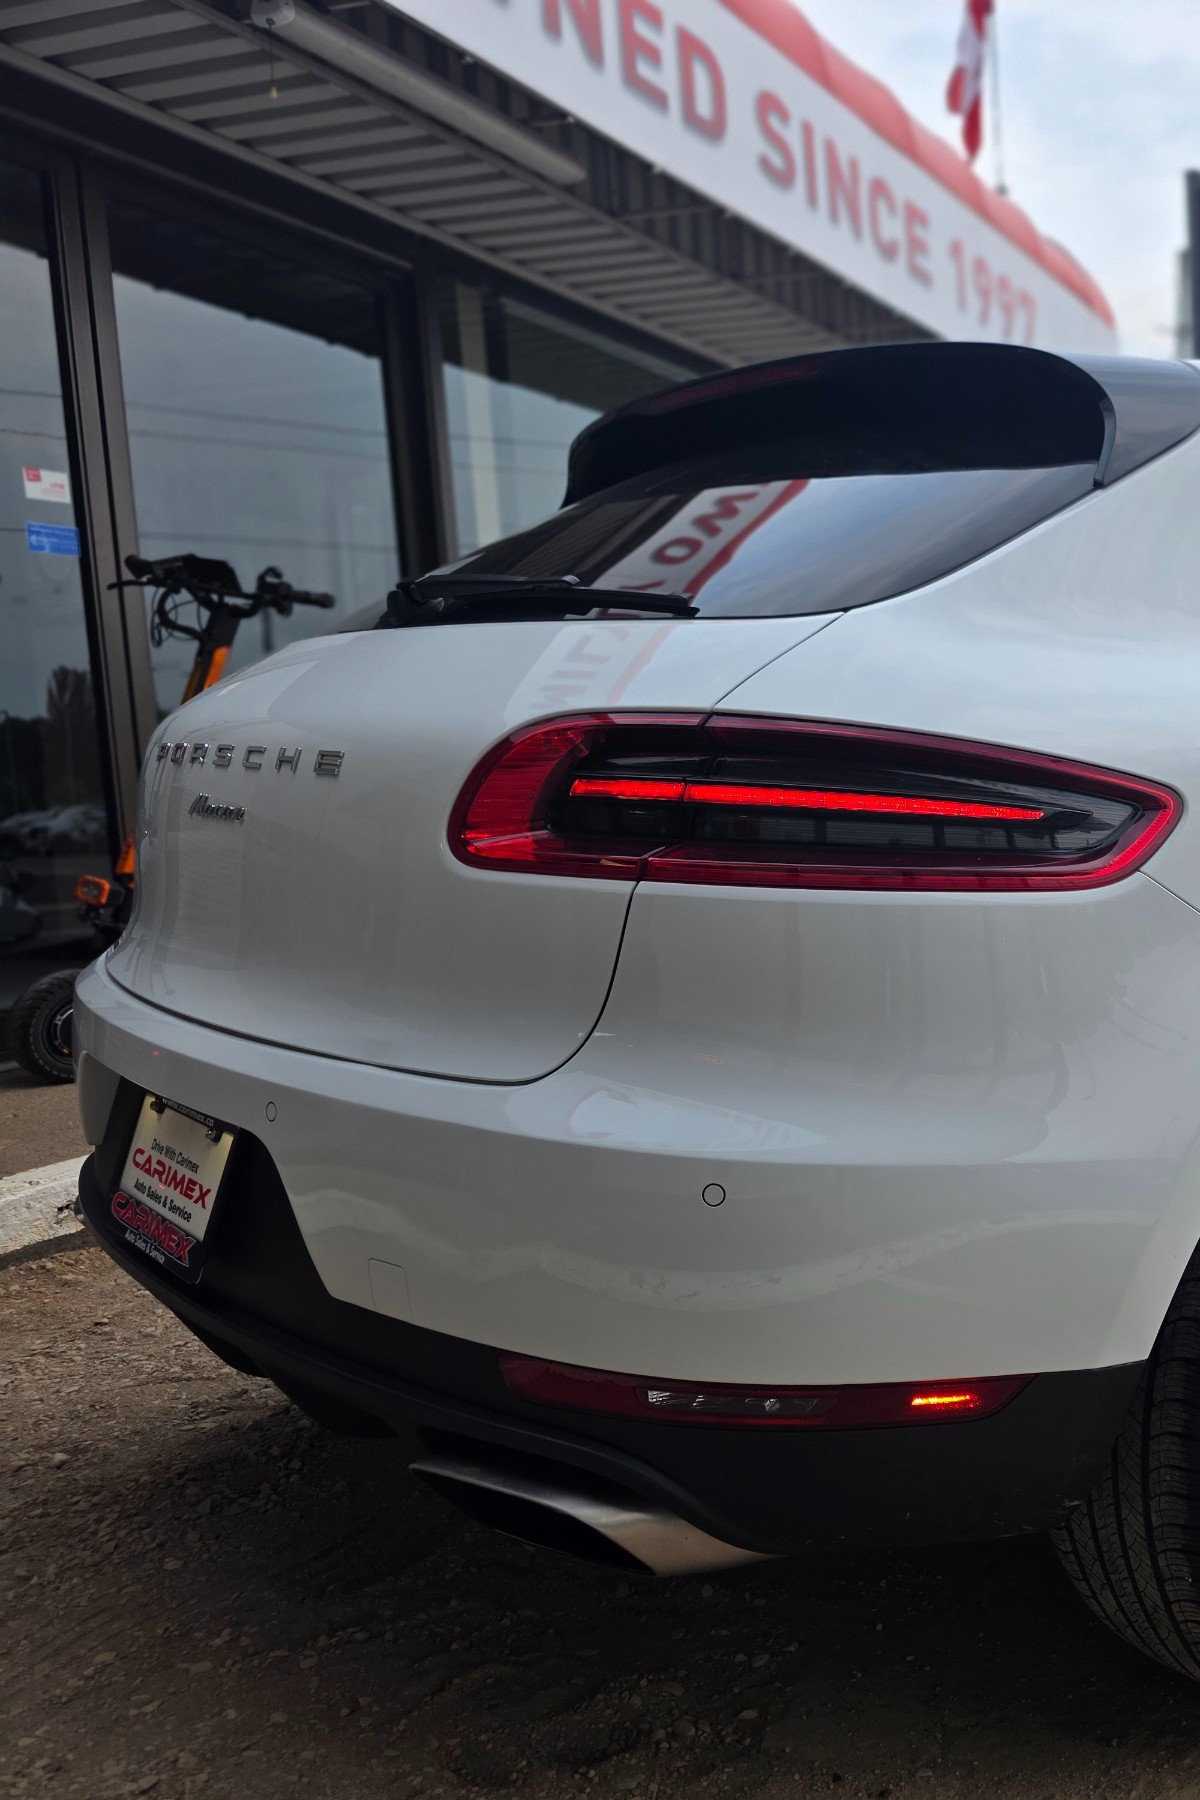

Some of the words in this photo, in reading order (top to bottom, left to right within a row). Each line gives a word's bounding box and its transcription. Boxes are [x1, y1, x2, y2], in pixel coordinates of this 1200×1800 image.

[493, 0, 729, 143] NED
[756, 88, 935, 289] SINCE
[948, 236, 1038, 346] 1997
[156, 742, 345, 776] PORSCHE
[188, 792, 246, 824] Macan
[151, 1138, 164, 1155] Drive
[164, 1145, 177, 1161] With
[176, 1152, 200, 1174] Carimex
[132, 1148, 212, 1209] CARIMEX
[134, 1178, 147, 1195] Auto
[146, 1185, 162, 1205] Sales
[162, 1195, 168, 1209] &
[168, 1199, 192, 1222] Service
[111, 1192, 195, 1267] CARIMEX
